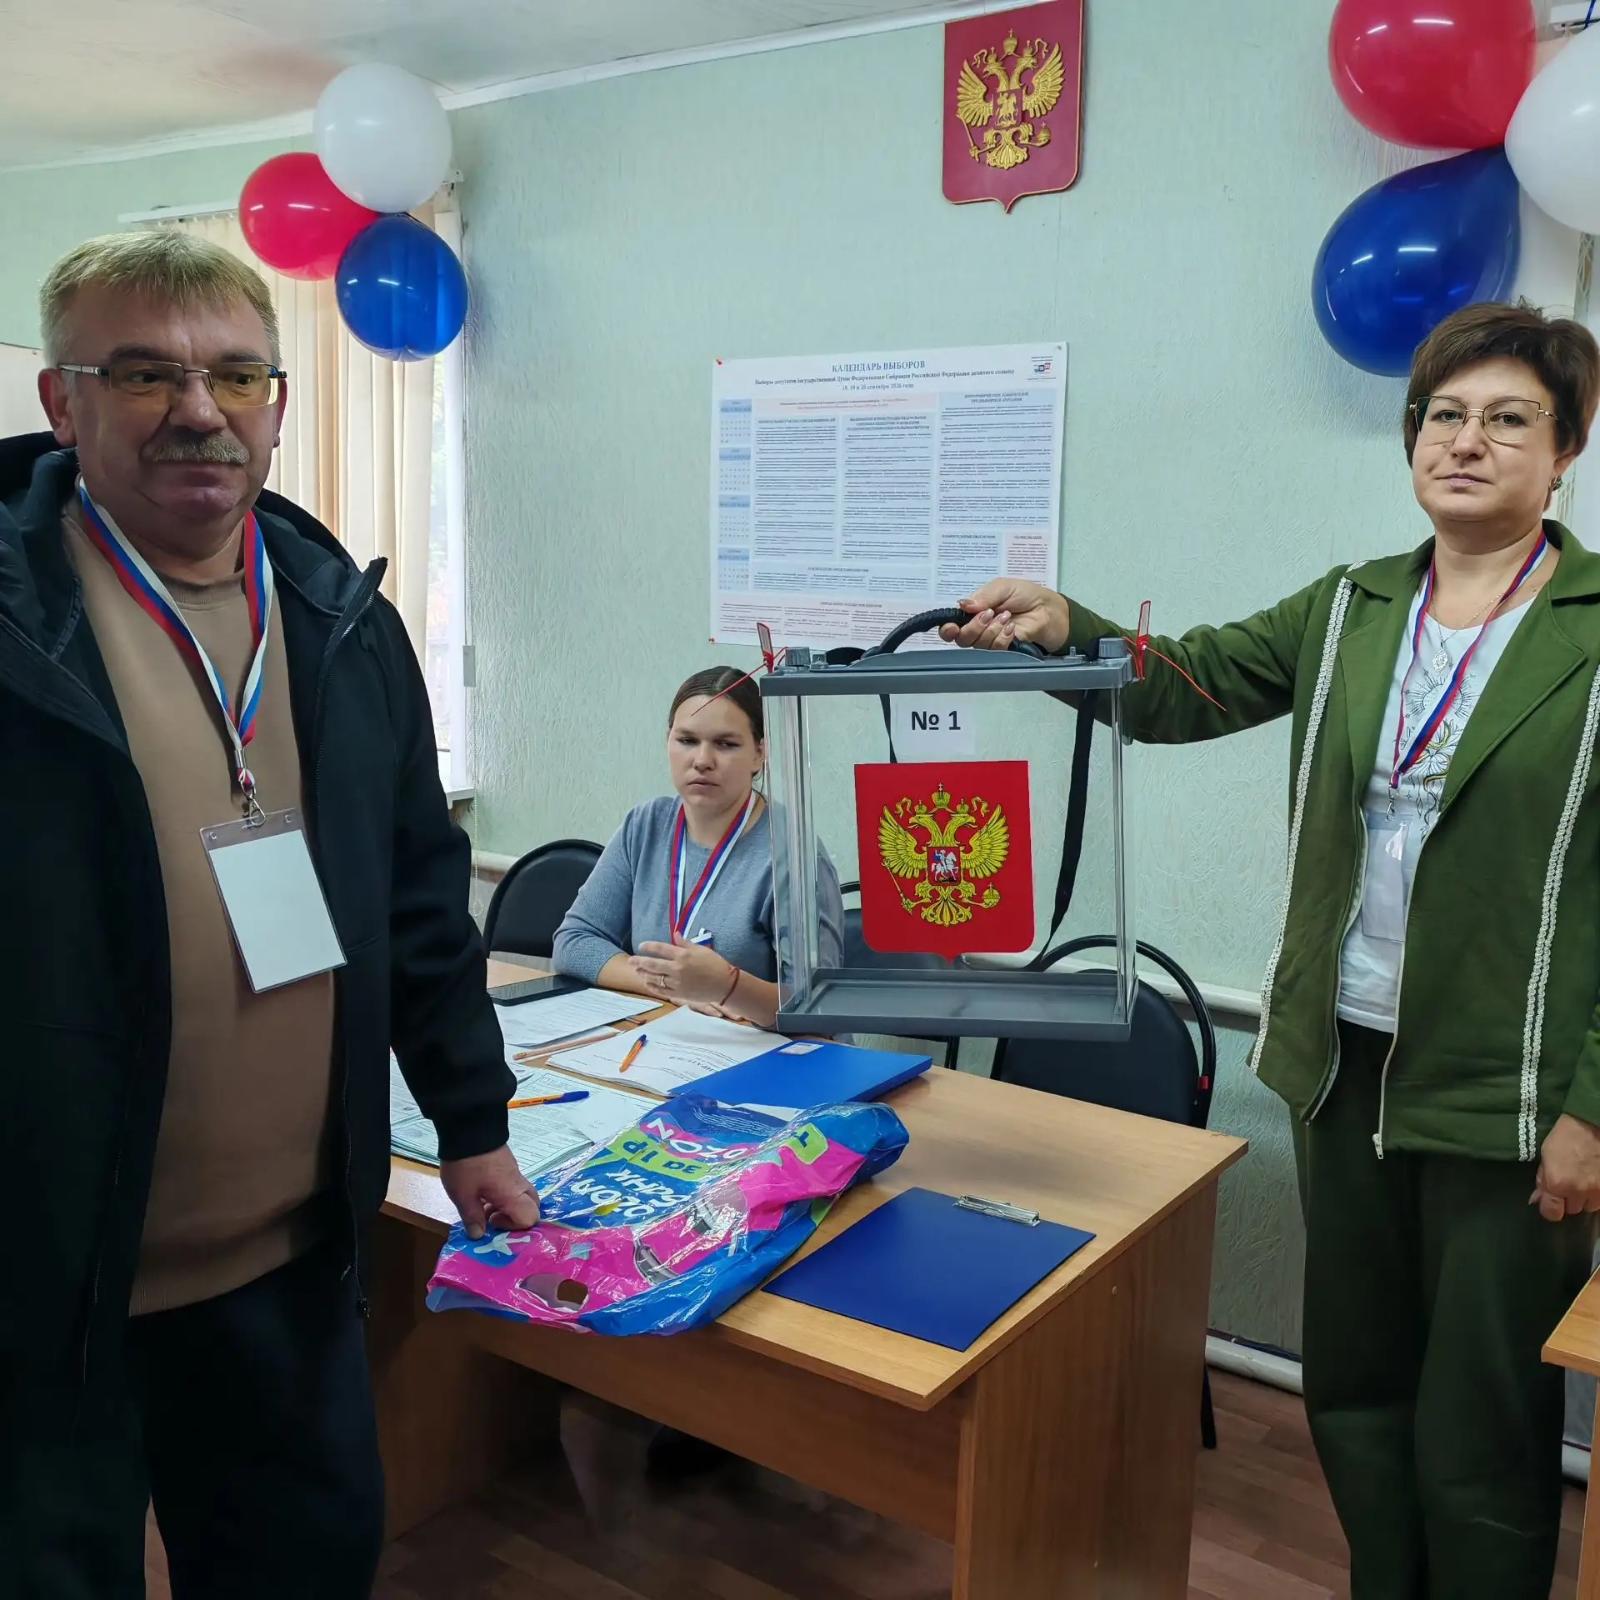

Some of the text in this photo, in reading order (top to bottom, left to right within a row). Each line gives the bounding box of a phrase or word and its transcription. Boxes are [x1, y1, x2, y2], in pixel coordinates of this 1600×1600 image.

[832, 360, 926, 373] КАЛЕНДАРЬ ВЫБОРОВ
[911, 710, 961, 731] № 1
